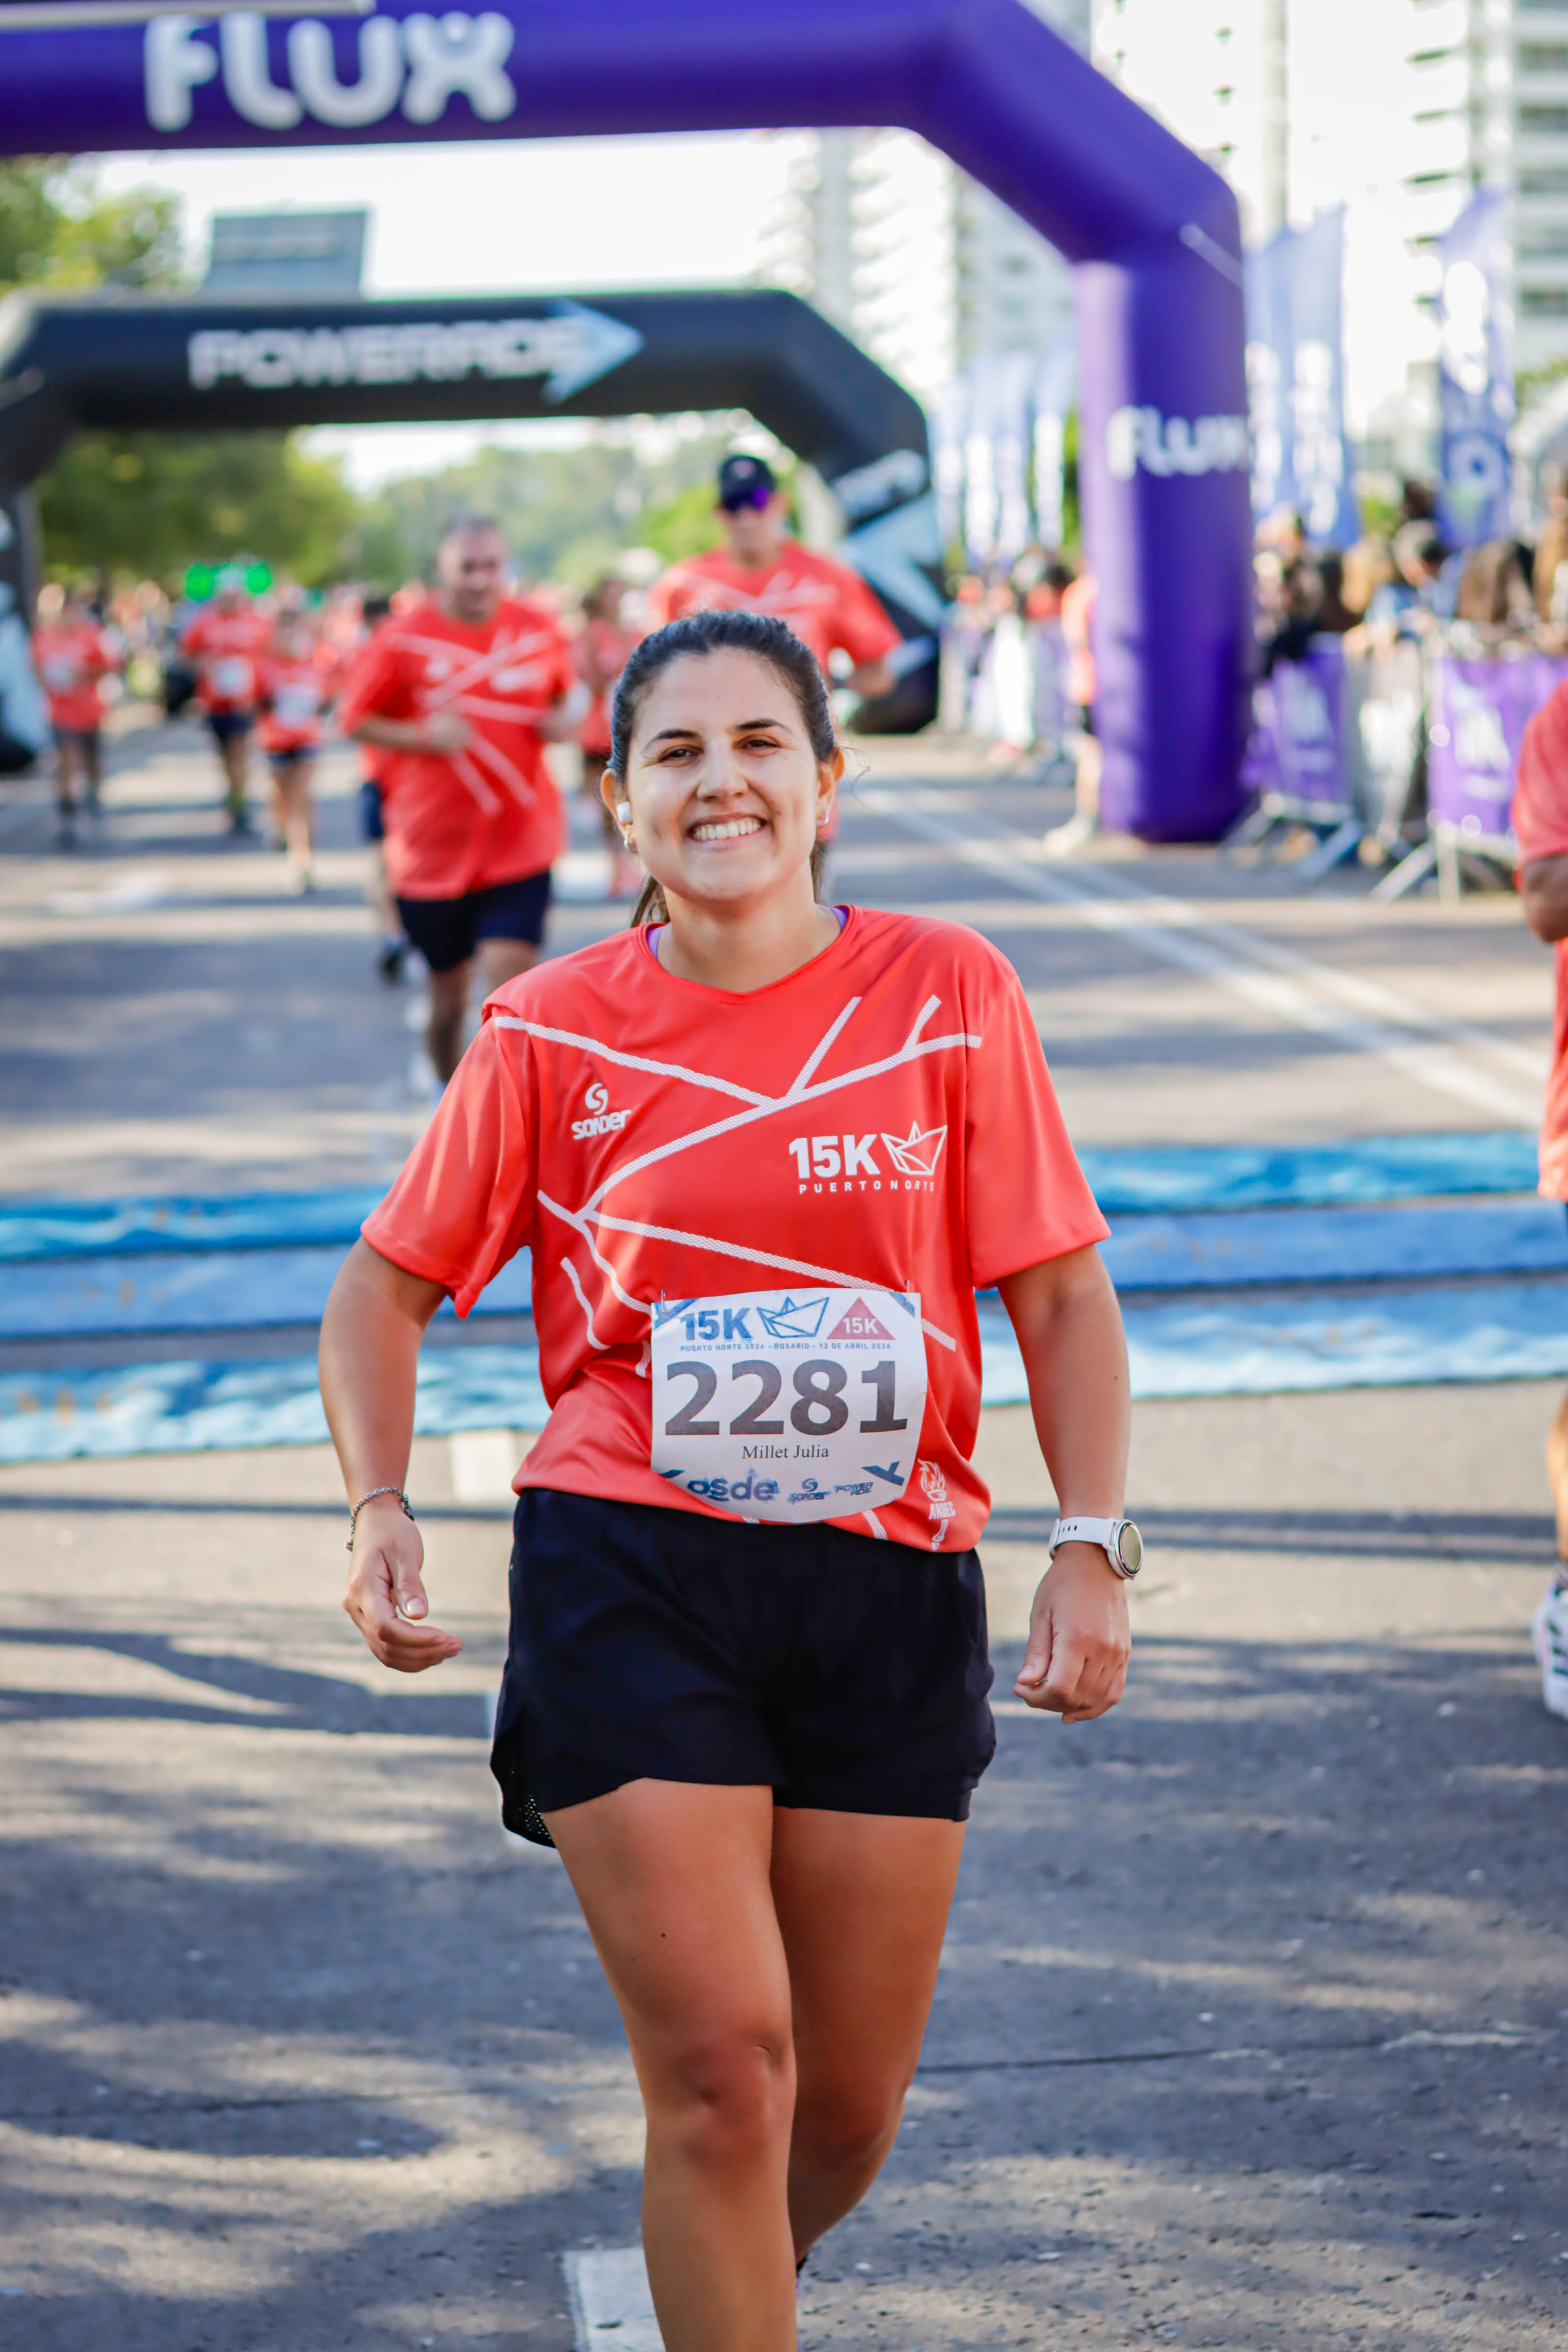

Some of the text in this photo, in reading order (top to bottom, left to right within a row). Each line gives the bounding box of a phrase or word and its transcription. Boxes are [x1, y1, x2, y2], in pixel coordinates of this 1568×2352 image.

[144, 11, 517, 133] FLUX
[789, 1134, 881, 1179] 15K
[799, 1180, 934, 1194] PUERTO NORTE
[680, 1308, 752, 1341] 15K
[843, 1317, 879, 1334] 15K
[665, 1359, 908, 1436] 2281
[742, 1444, 829, 1459] Millet Julia
[687, 1472, 778, 1501] osde
